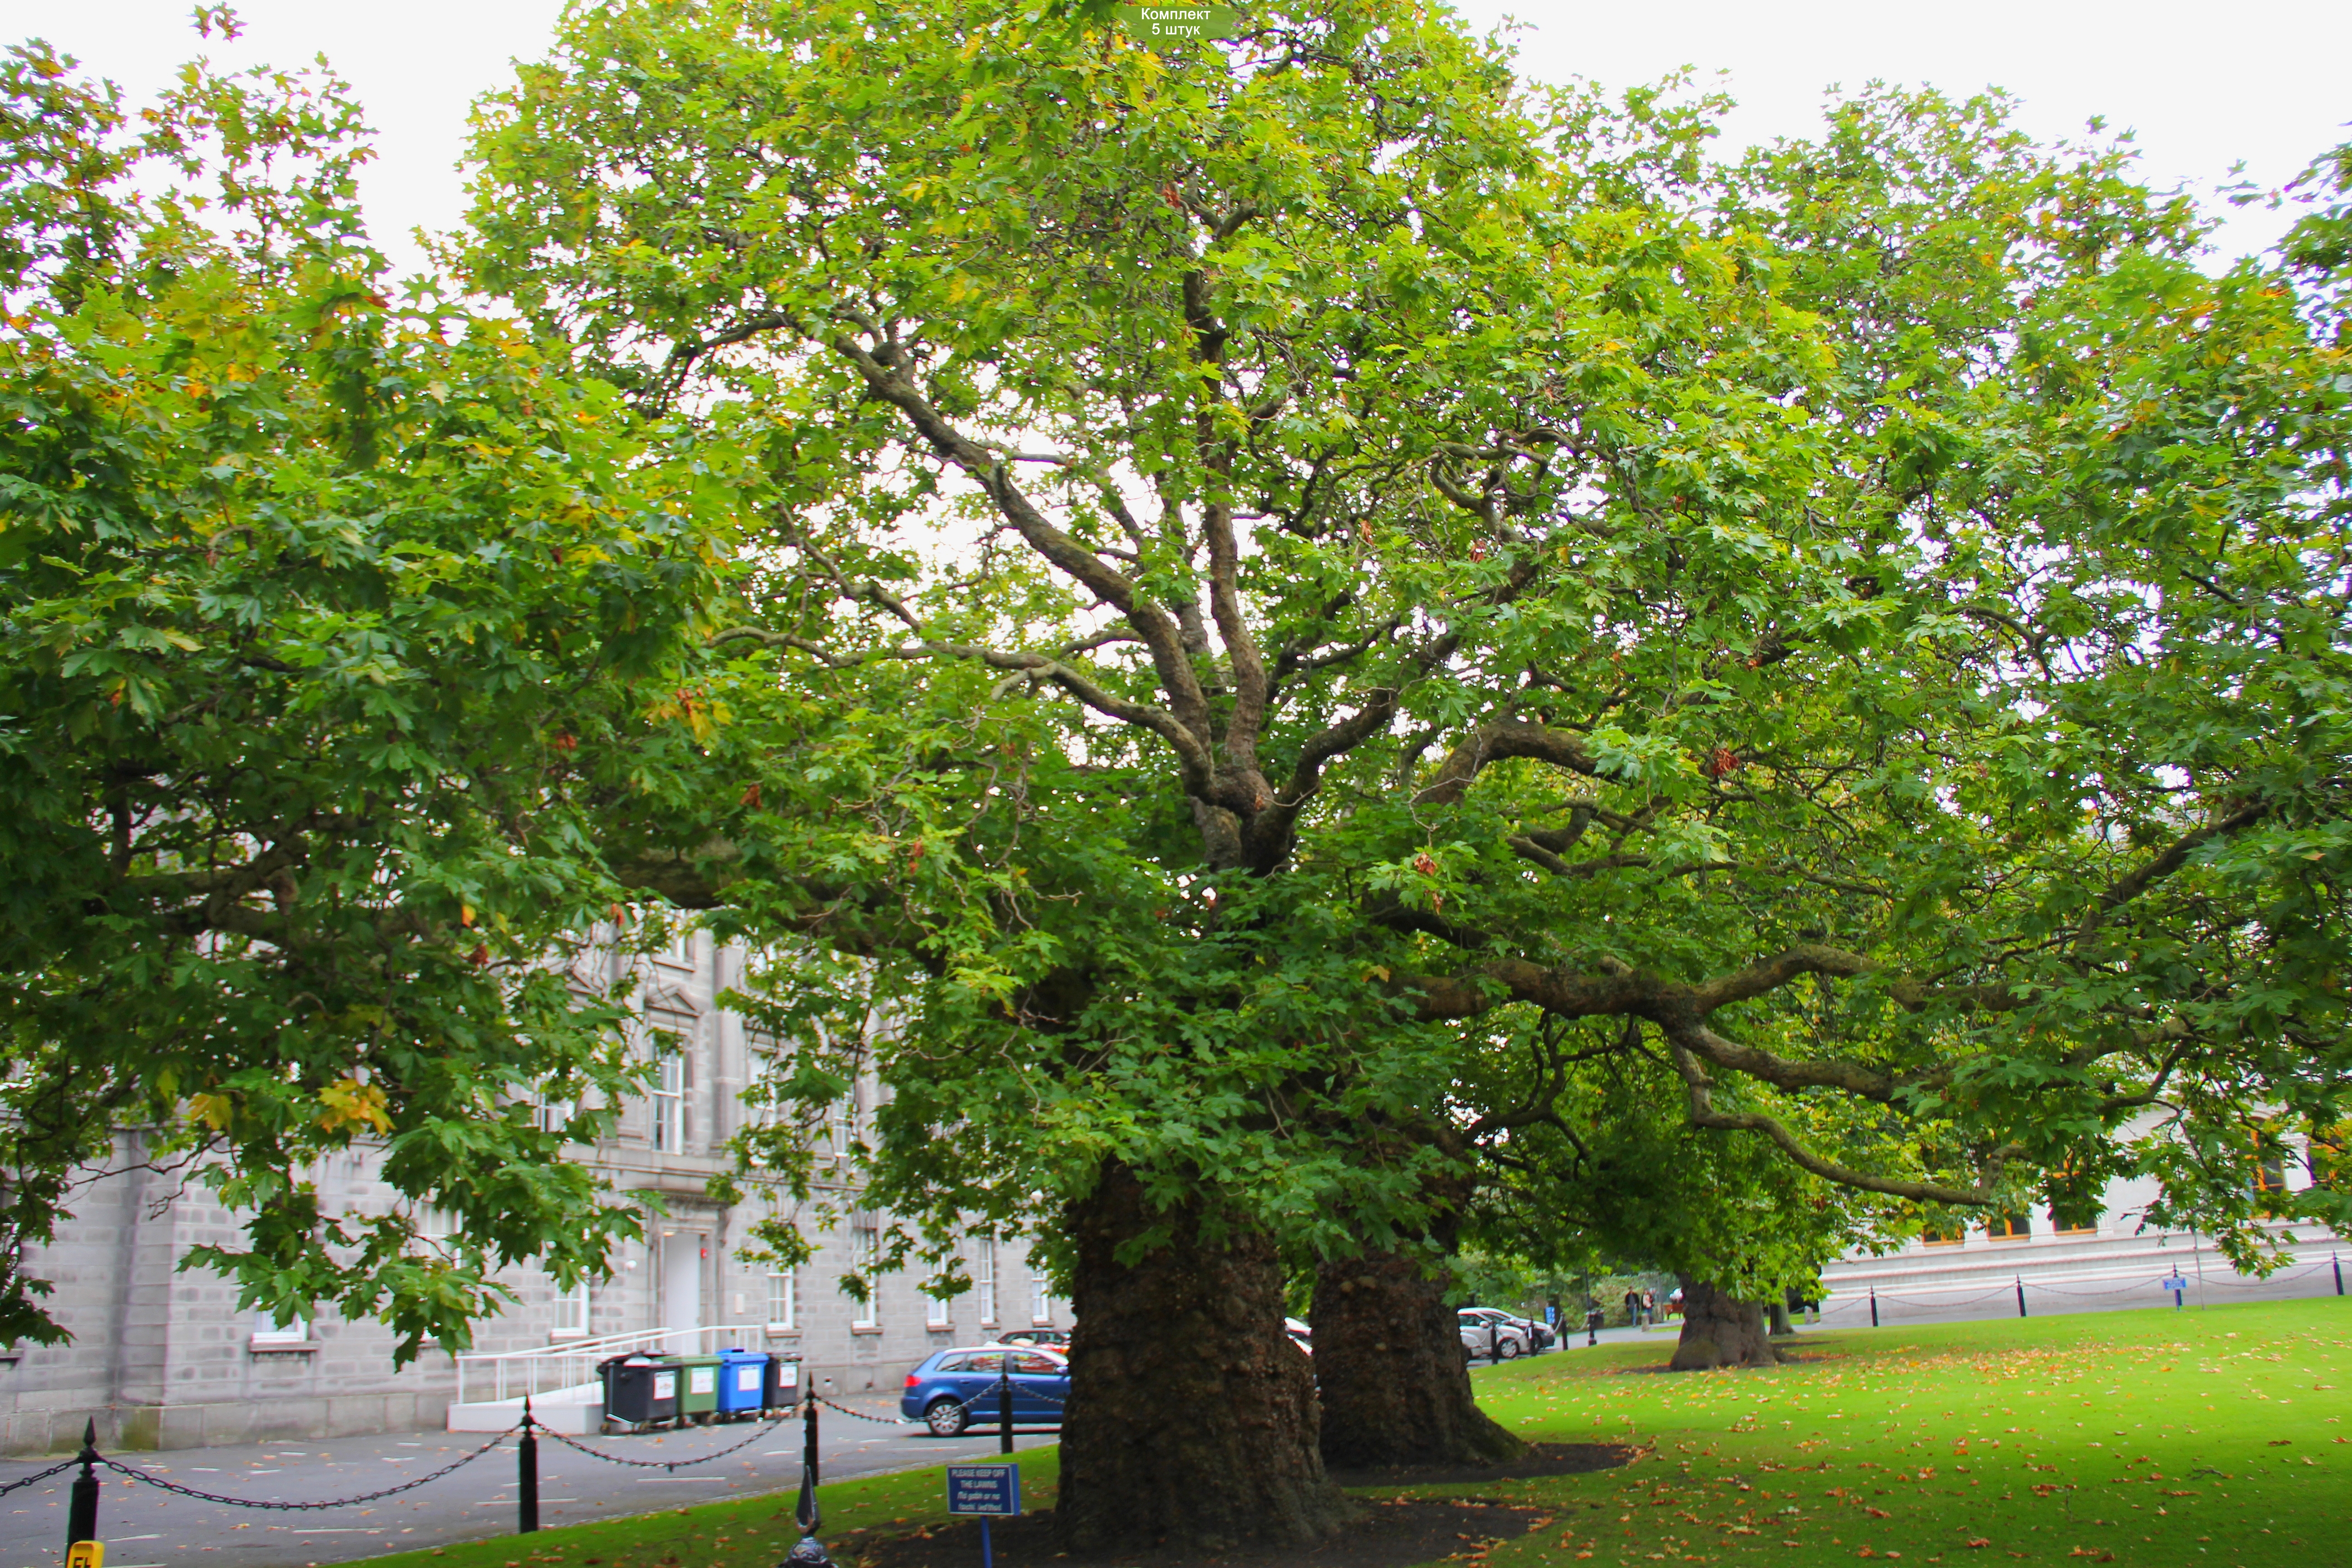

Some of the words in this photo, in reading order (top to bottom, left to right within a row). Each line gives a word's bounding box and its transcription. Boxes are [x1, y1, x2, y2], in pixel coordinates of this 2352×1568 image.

[951, 1469, 975, 1477] PLEASE
[975, 1469, 992, 1478] KEEP
[992, 1469, 1006, 1478] OFF
[960, 1480, 974, 1489] THE
[974, 1480, 998, 1489] LAWNS
